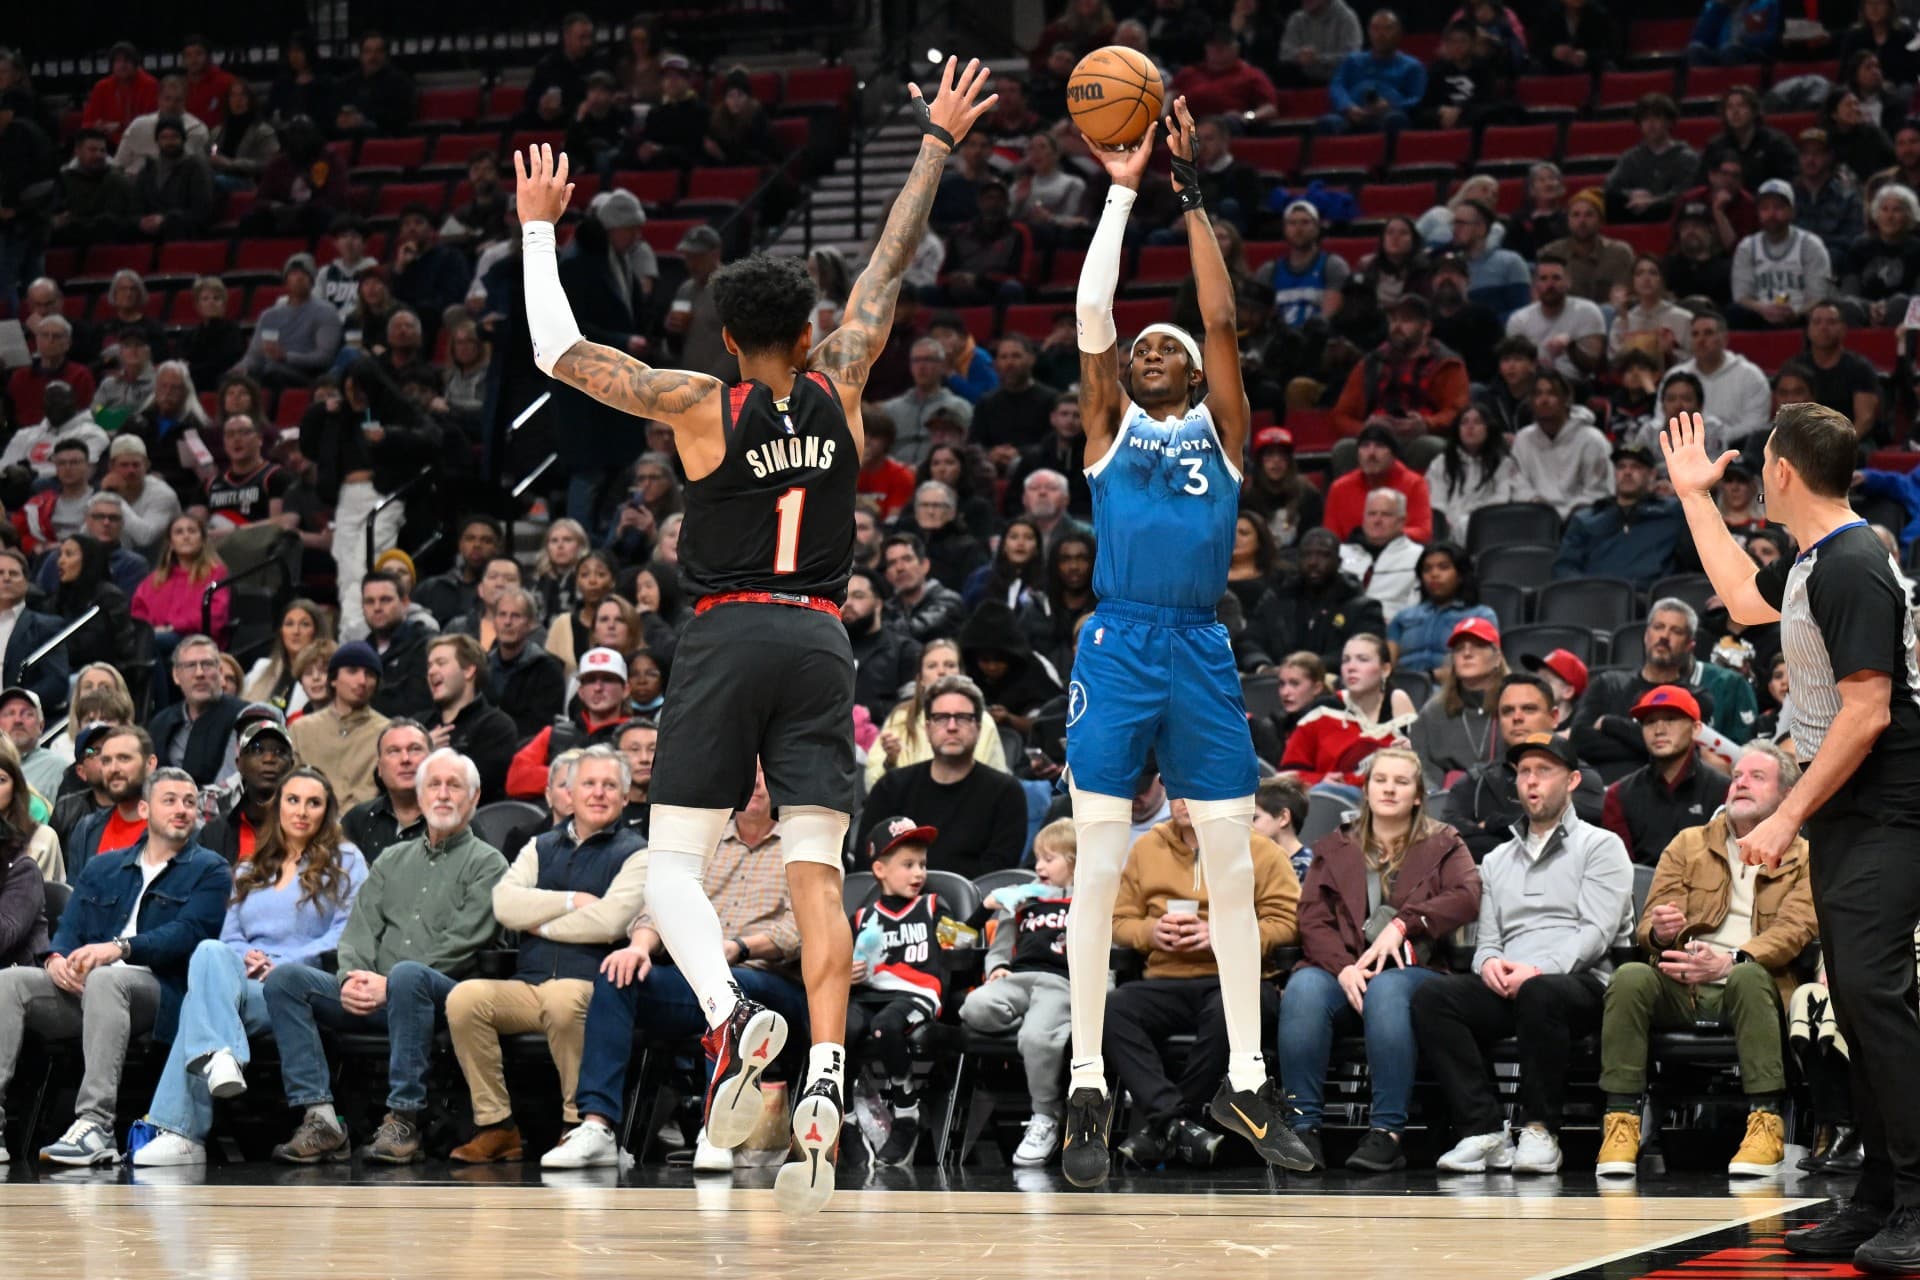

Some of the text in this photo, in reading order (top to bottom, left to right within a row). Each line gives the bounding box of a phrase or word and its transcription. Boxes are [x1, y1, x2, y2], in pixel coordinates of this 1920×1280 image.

[746, 436, 836, 478] SIMONS
[1129, 436, 1212, 458] MINEOTA
[1180, 458, 1209, 496] 3
[773, 488, 807, 575] 1
[904, 941, 929, 963] 00
